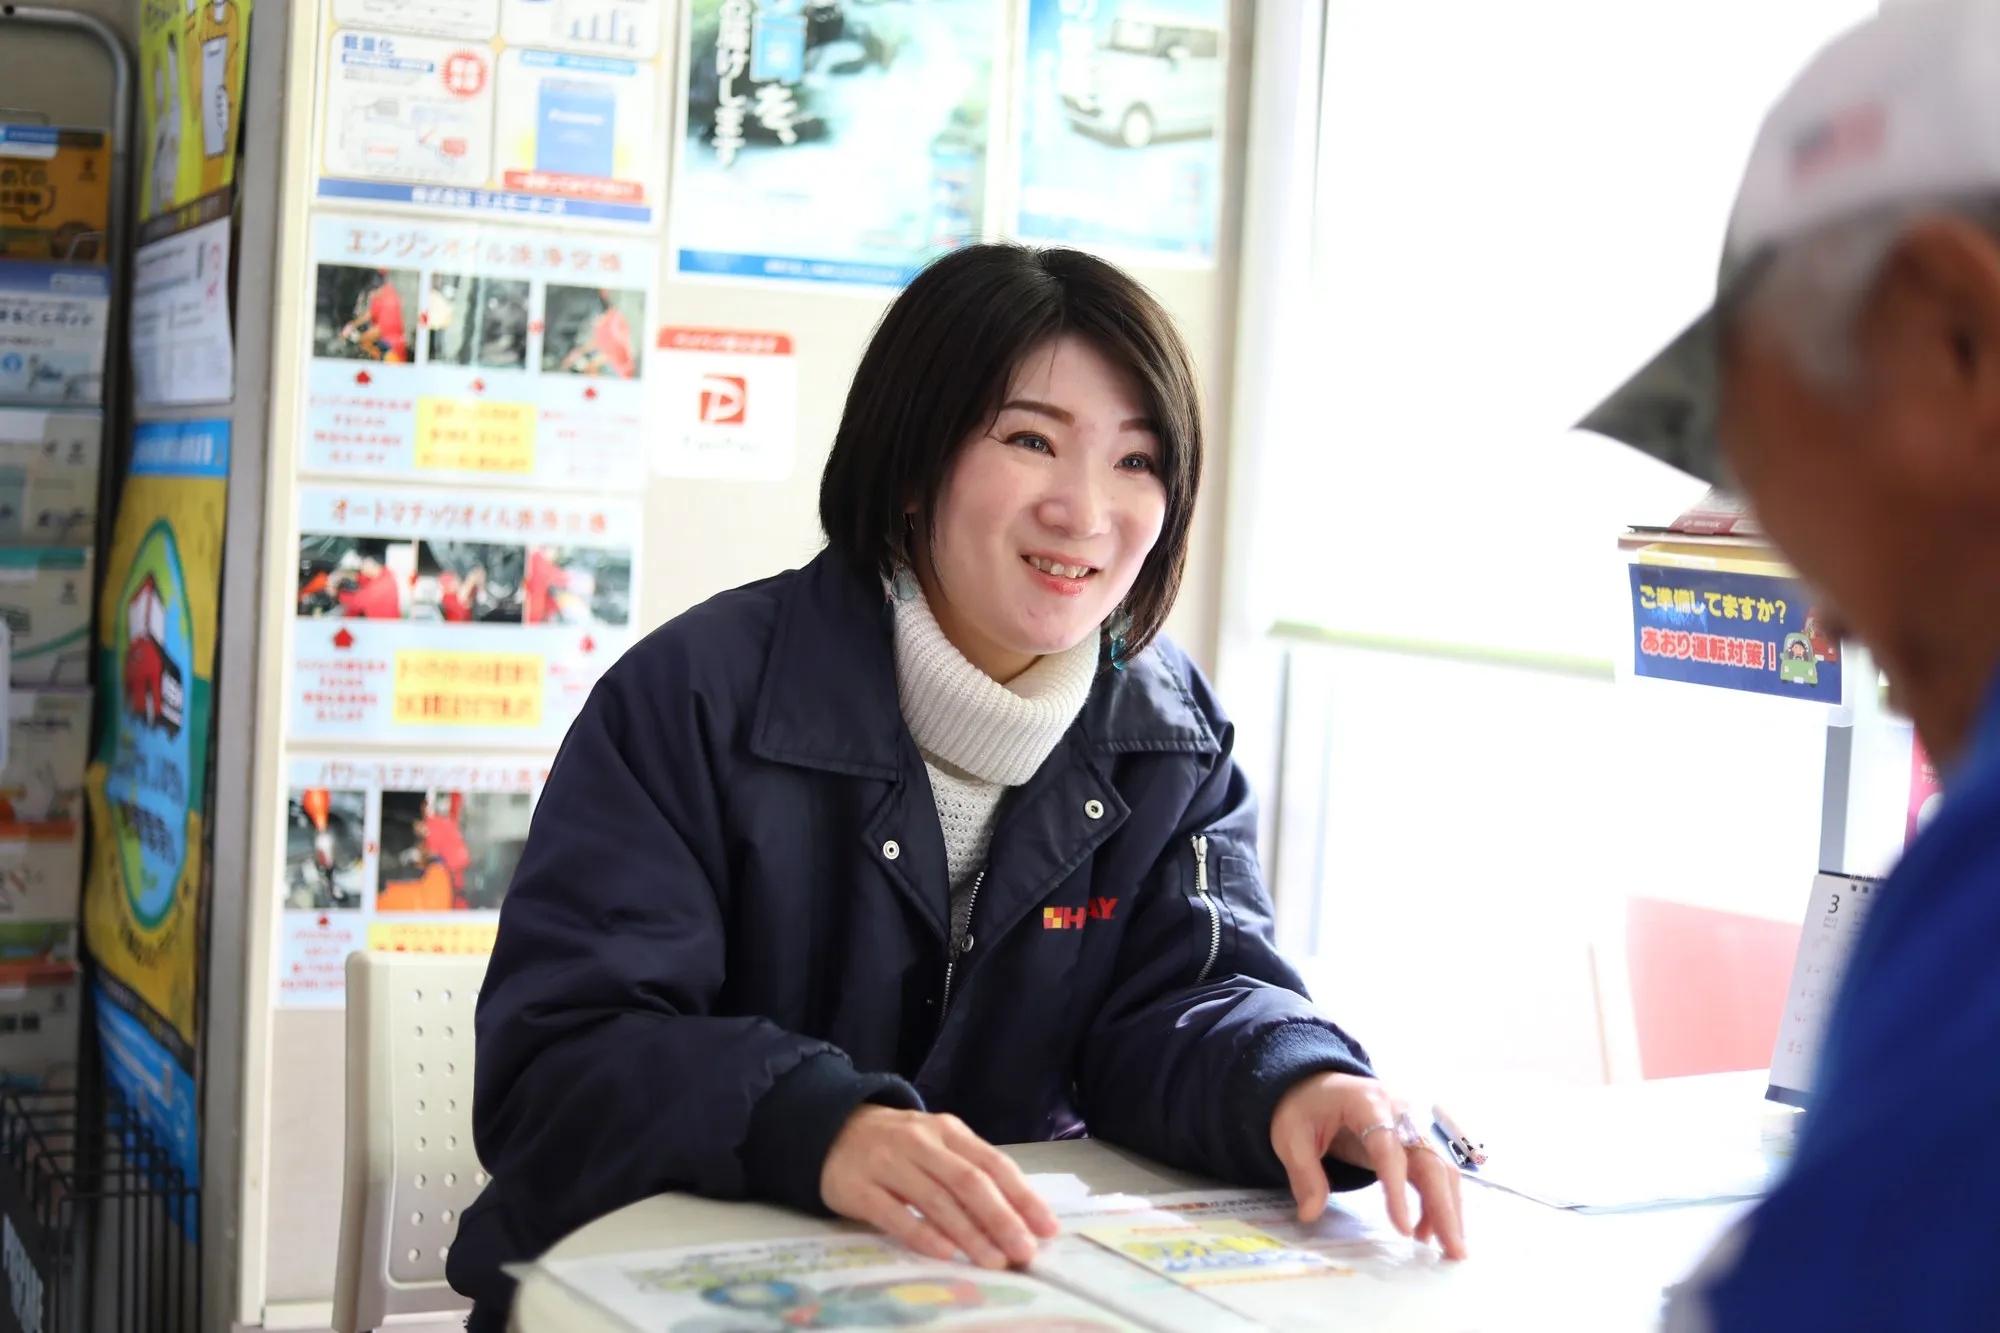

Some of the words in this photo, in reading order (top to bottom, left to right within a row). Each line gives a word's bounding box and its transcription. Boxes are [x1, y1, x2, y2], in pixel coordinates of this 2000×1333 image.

[1639, 584, 1787, 625] ご準備してますか?
[1640, 626, 1777, 671] あおり運転対策！
[1827, 894, 1841, 915] 3
